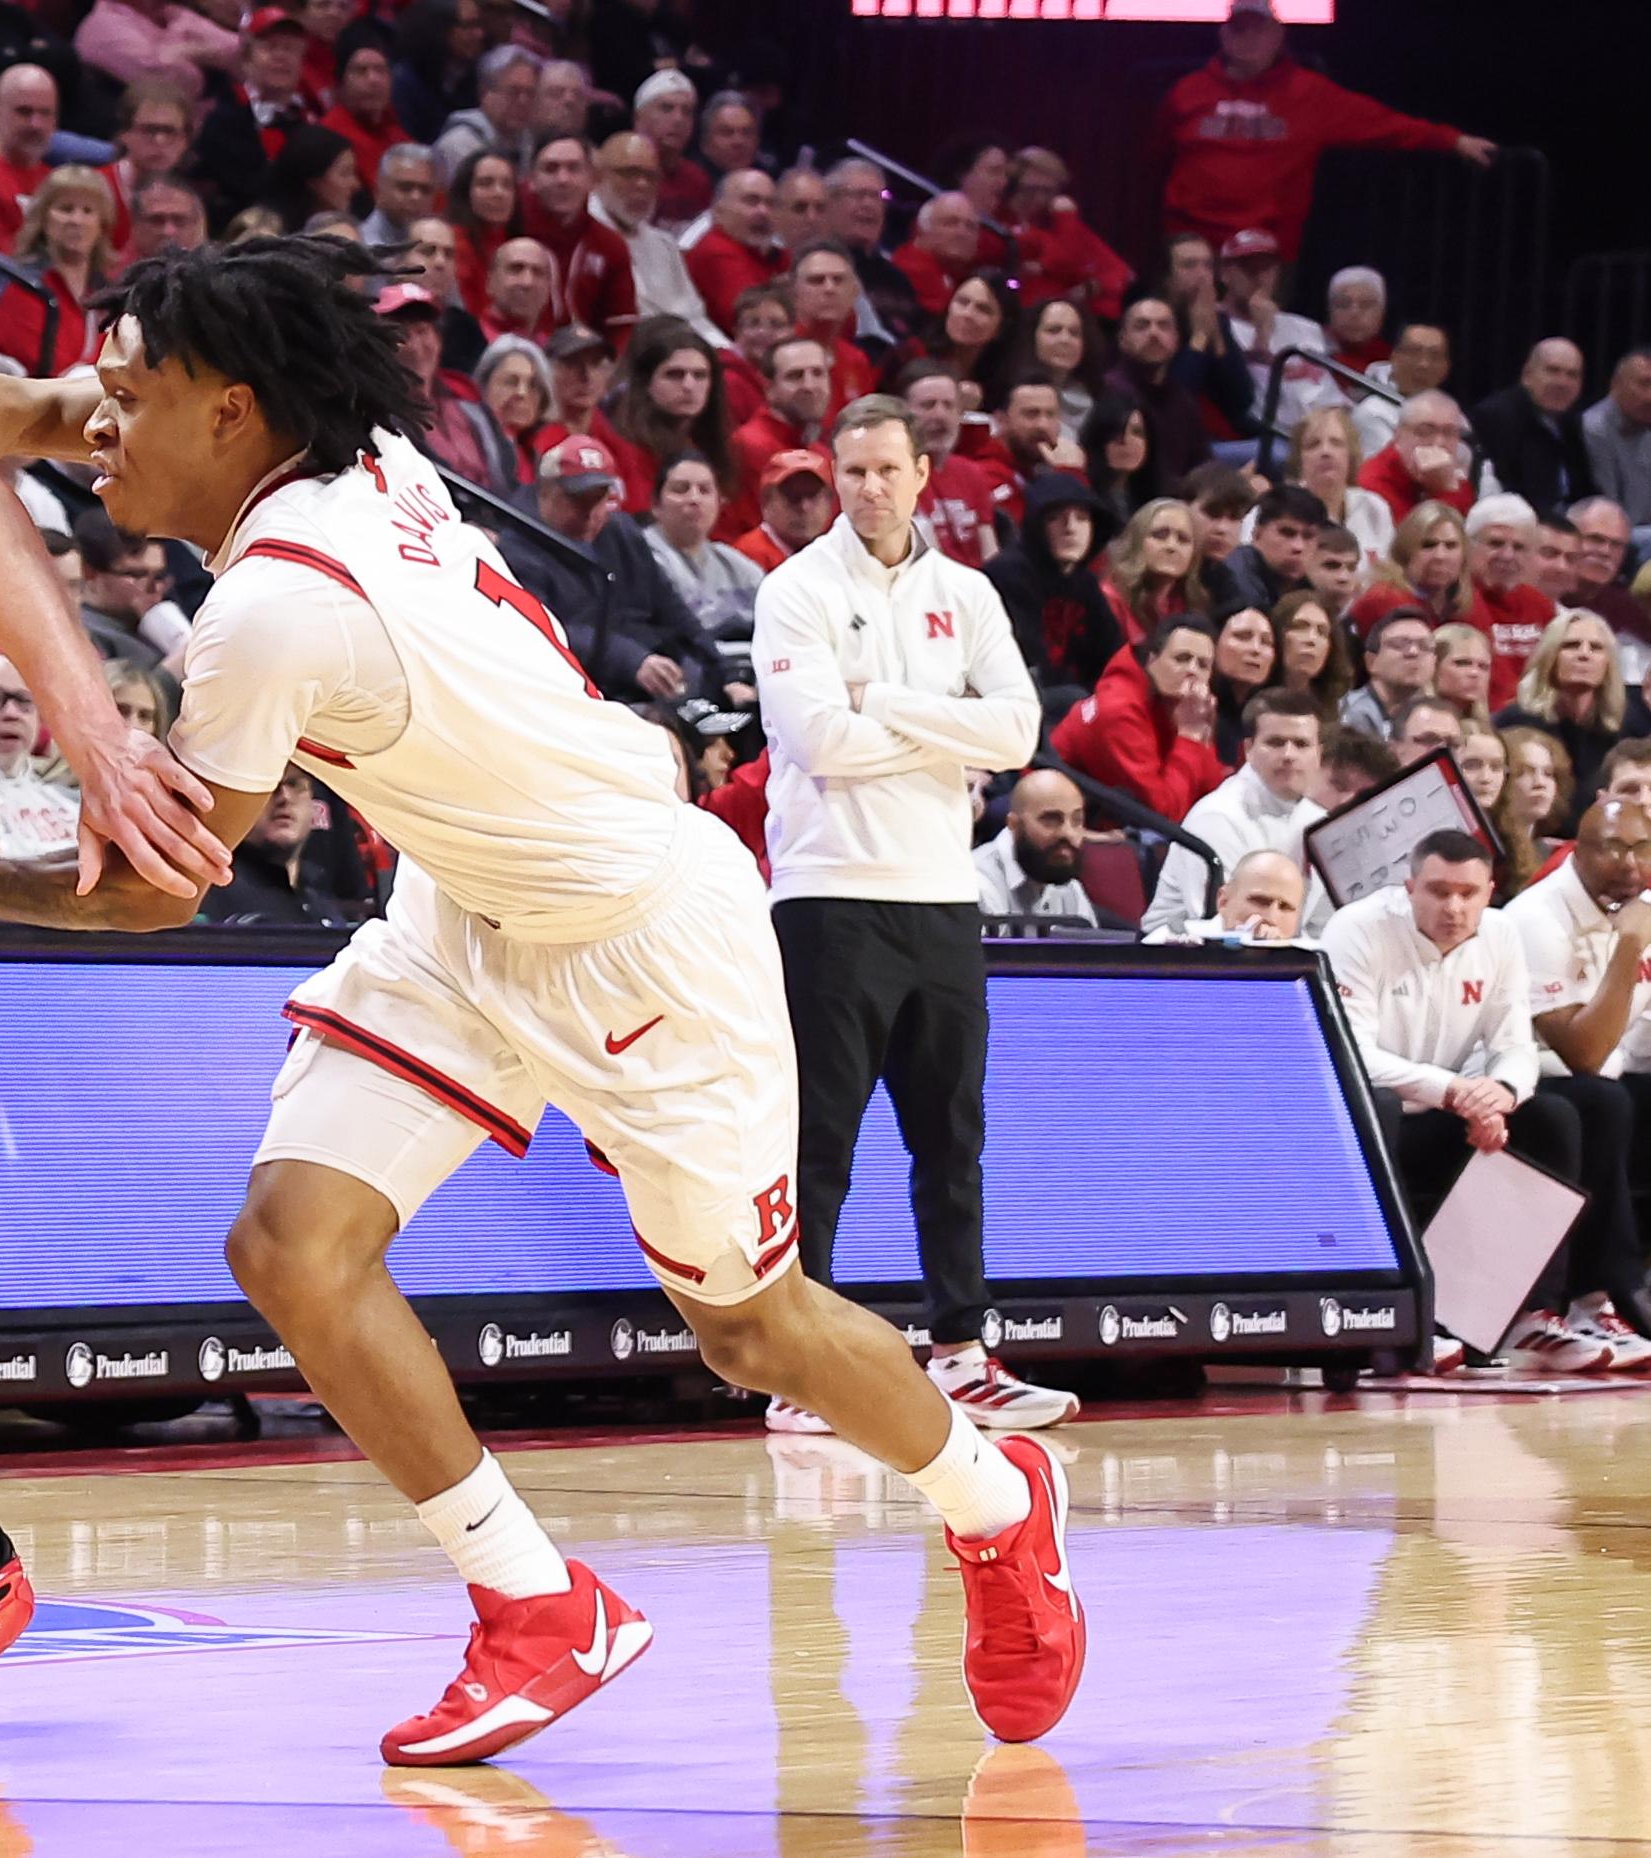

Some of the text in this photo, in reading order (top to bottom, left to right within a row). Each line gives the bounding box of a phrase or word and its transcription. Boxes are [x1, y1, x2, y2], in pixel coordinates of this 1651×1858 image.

[391, 483, 450, 567] DAVIS
[924, 611, 956, 639] N
[1460, 979, 1484, 1005] N
[752, 1173, 794, 1247] R
[1005, 1316, 1062, 1341] Prudential
[1232, 1310, 1287, 1335] Prudential
[1343, 1307, 1395, 1330] Prudential
[505, 1330, 571, 1358] Prudential
[96, 1350, 169, 1379] Prudential
